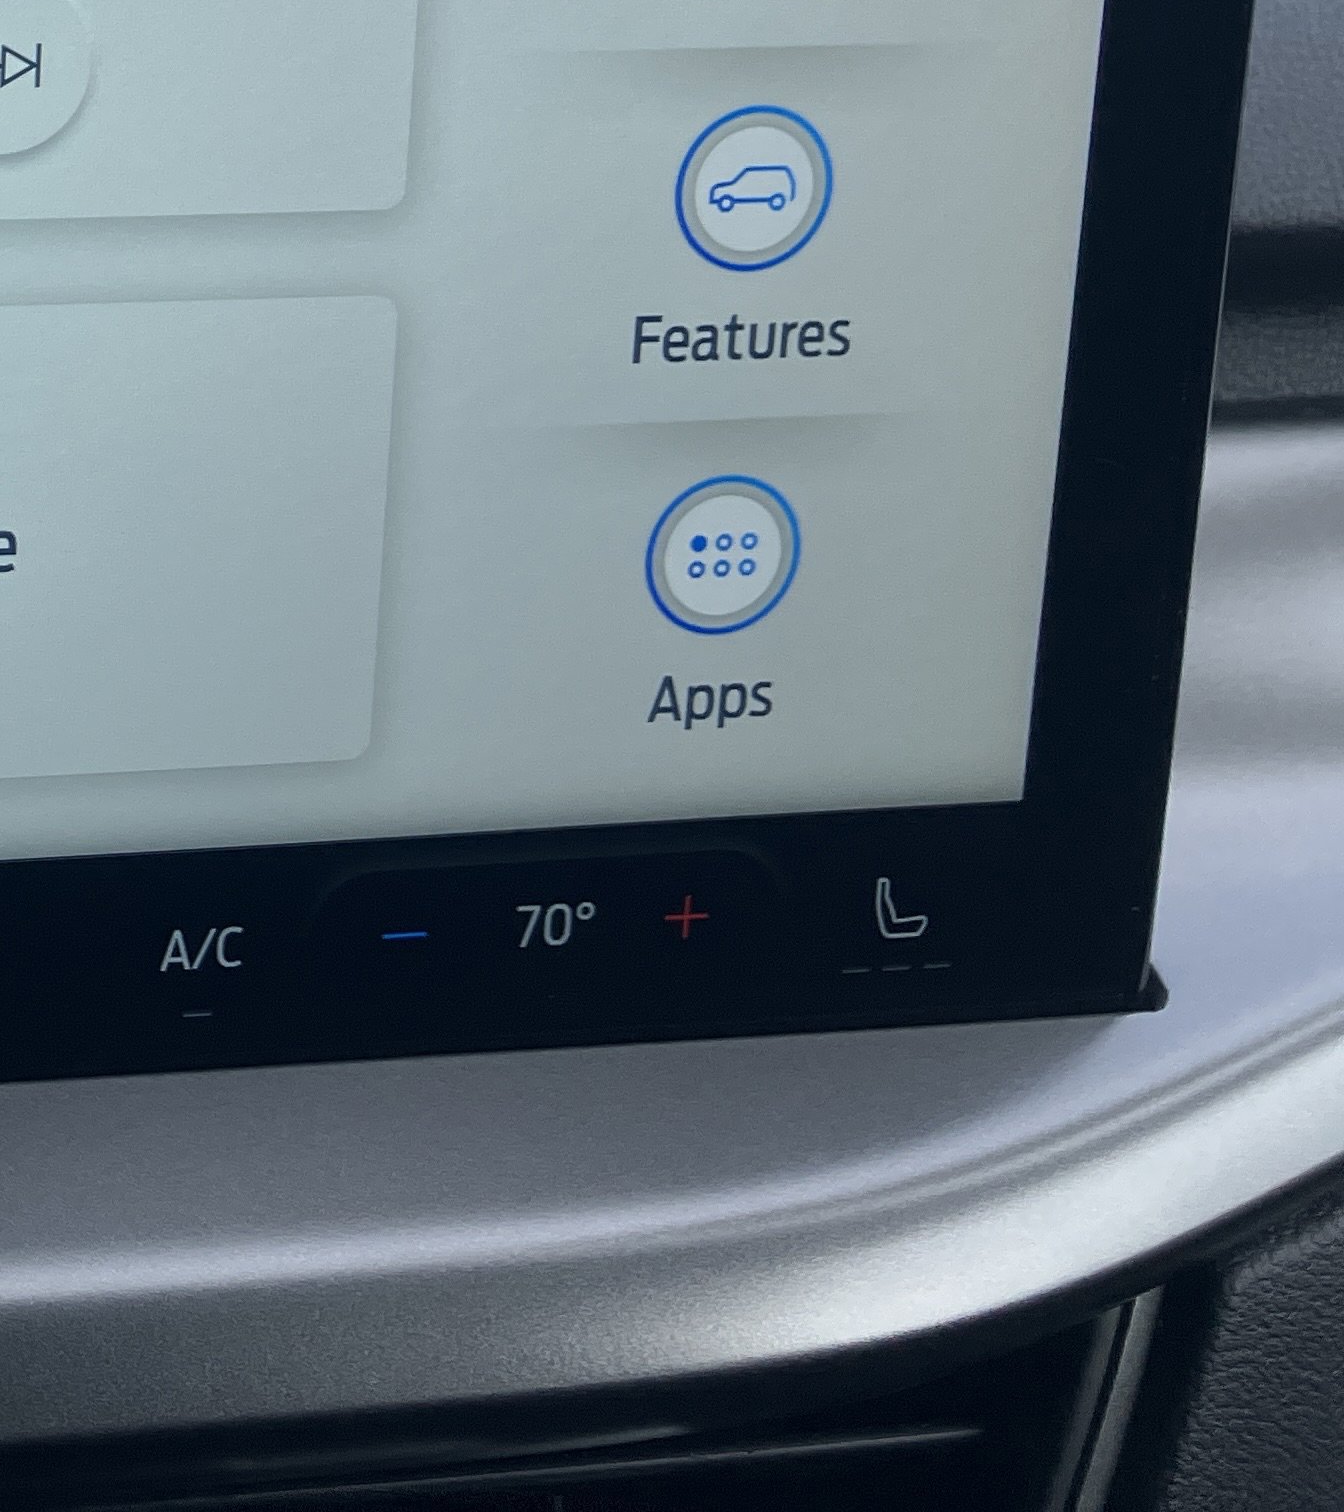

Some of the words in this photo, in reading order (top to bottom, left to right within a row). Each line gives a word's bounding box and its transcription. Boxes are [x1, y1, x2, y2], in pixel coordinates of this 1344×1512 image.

[631, 314, 851, 364] Features
[647, 675, 773, 730] Apps
[160, 925, 244, 972] A/C
[515, 901, 596, 948] 70°
